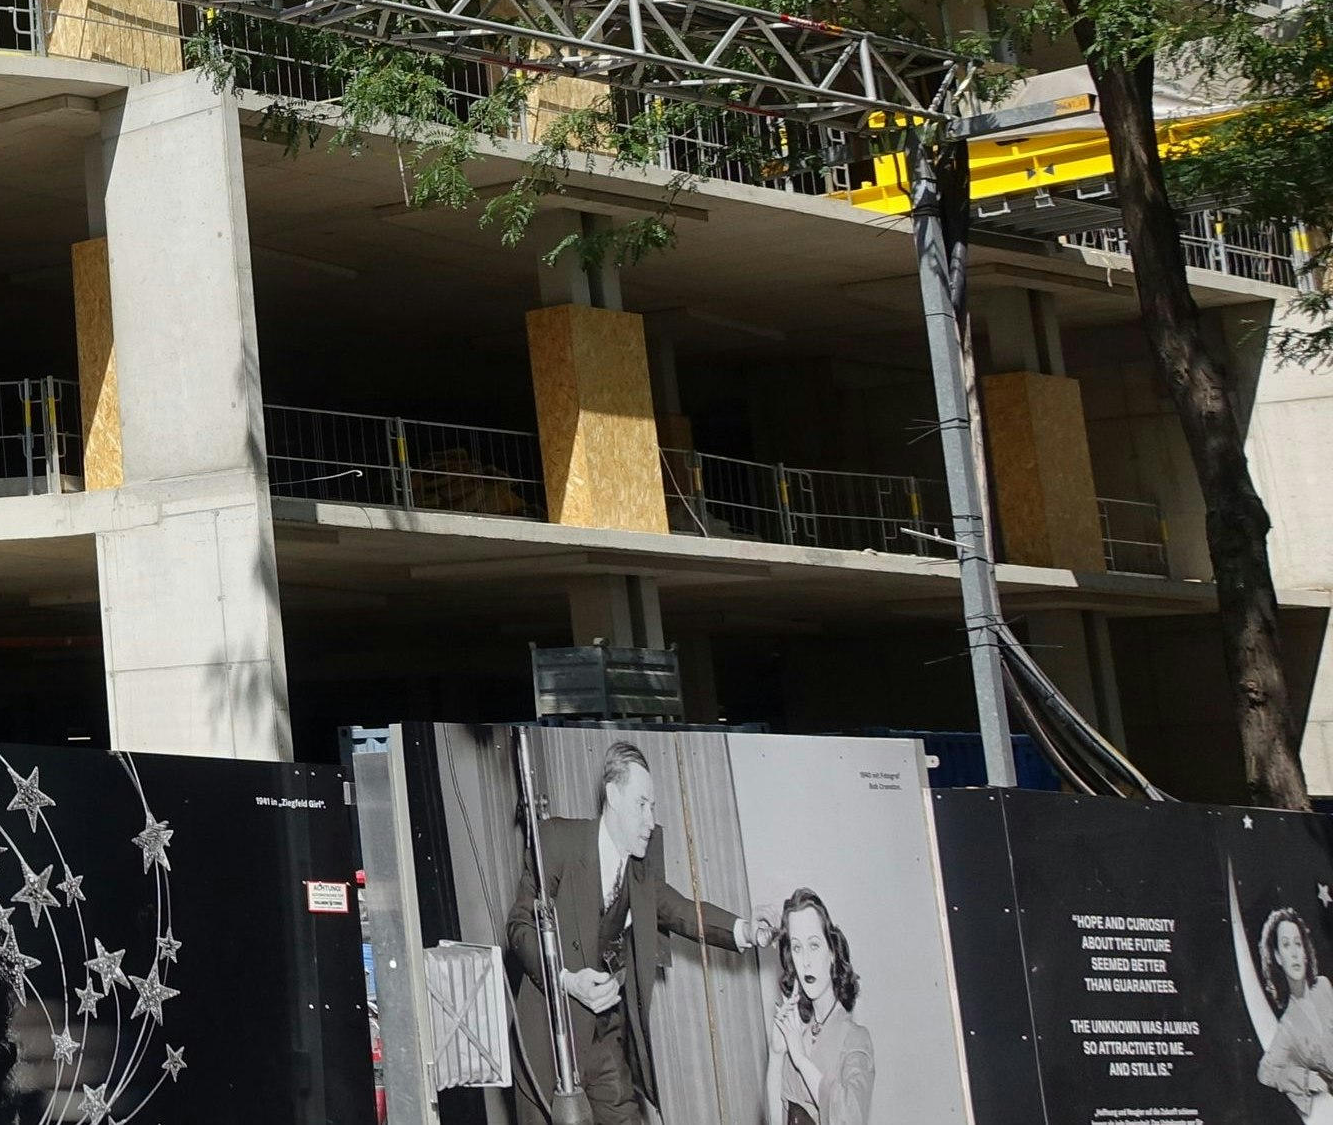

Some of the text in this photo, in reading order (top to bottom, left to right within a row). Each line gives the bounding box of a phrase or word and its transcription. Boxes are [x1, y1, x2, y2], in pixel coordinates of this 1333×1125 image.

[255, 796, 270, 806] 1941
[1105, 916, 1125, 930] AND
[1126, 917, 1175, 933] CURIOSITY
[1082, 936, 1172, 953] ABOUT THE FUTURE
[1091, 956, 1168, 973] SEEMED BETTER
[1084, 977, 1178, 994] THAN GUARANTEES.
[1070, 1019, 1200, 1035] THE UNKNOWN WAS ALWAYS
[1083, 1041, 1098, 1055] SO
[1098, 1041, 1155, 1055] ATTRACTIVE
[1155, 1041, 1168, 1055] TO
[1109, 1062, 1130, 1076] AND
[1131, 1062, 1157, 1076] STILL
